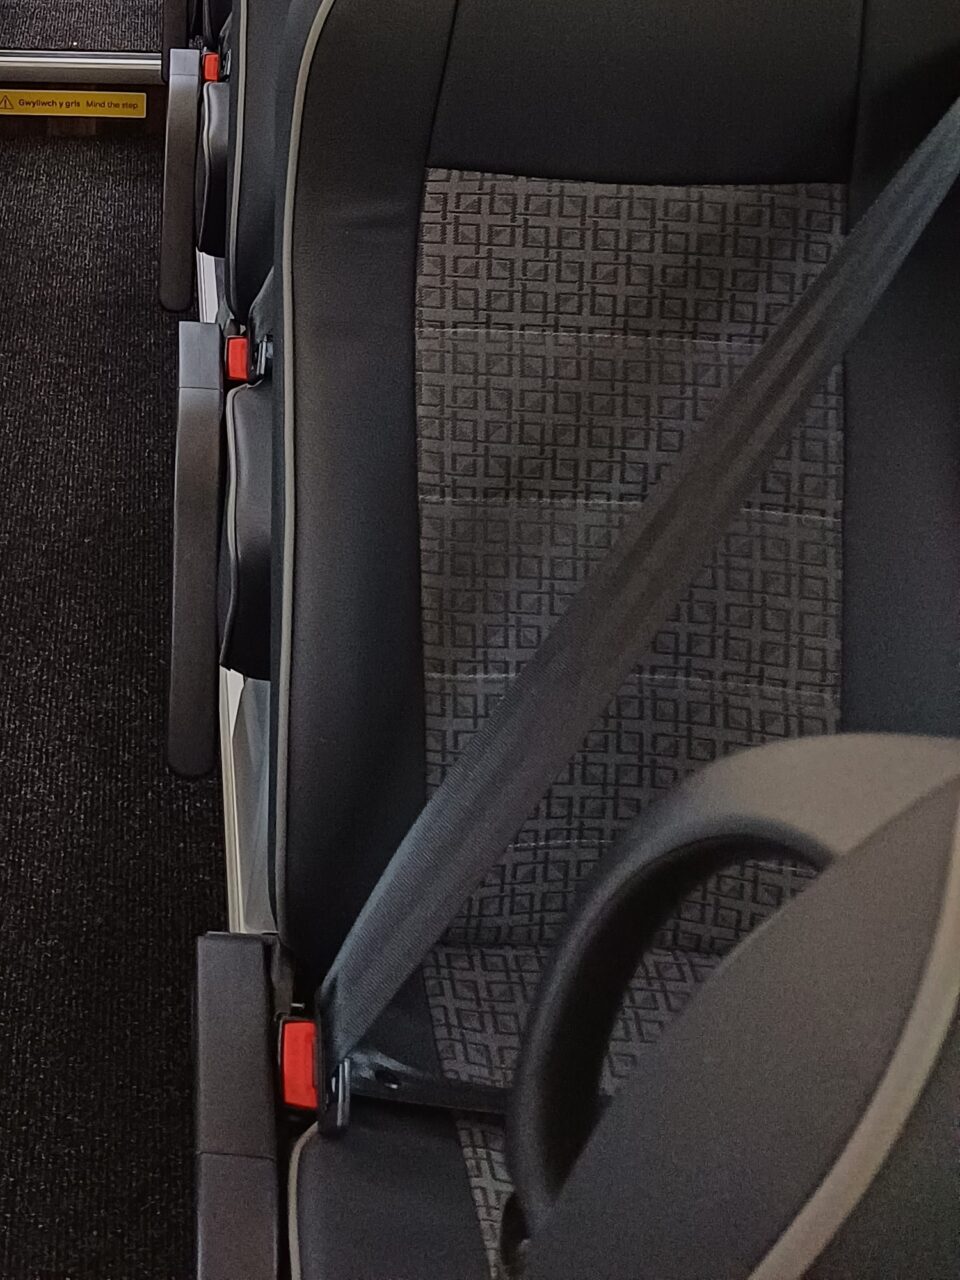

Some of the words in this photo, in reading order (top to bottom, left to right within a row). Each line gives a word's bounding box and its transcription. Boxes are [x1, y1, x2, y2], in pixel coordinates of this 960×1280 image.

[65, 99, 81, 109] gris
[86, 99, 106, 108] Mind
[107, 100, 121, 109] the
[121, 101, 138, 110] step
